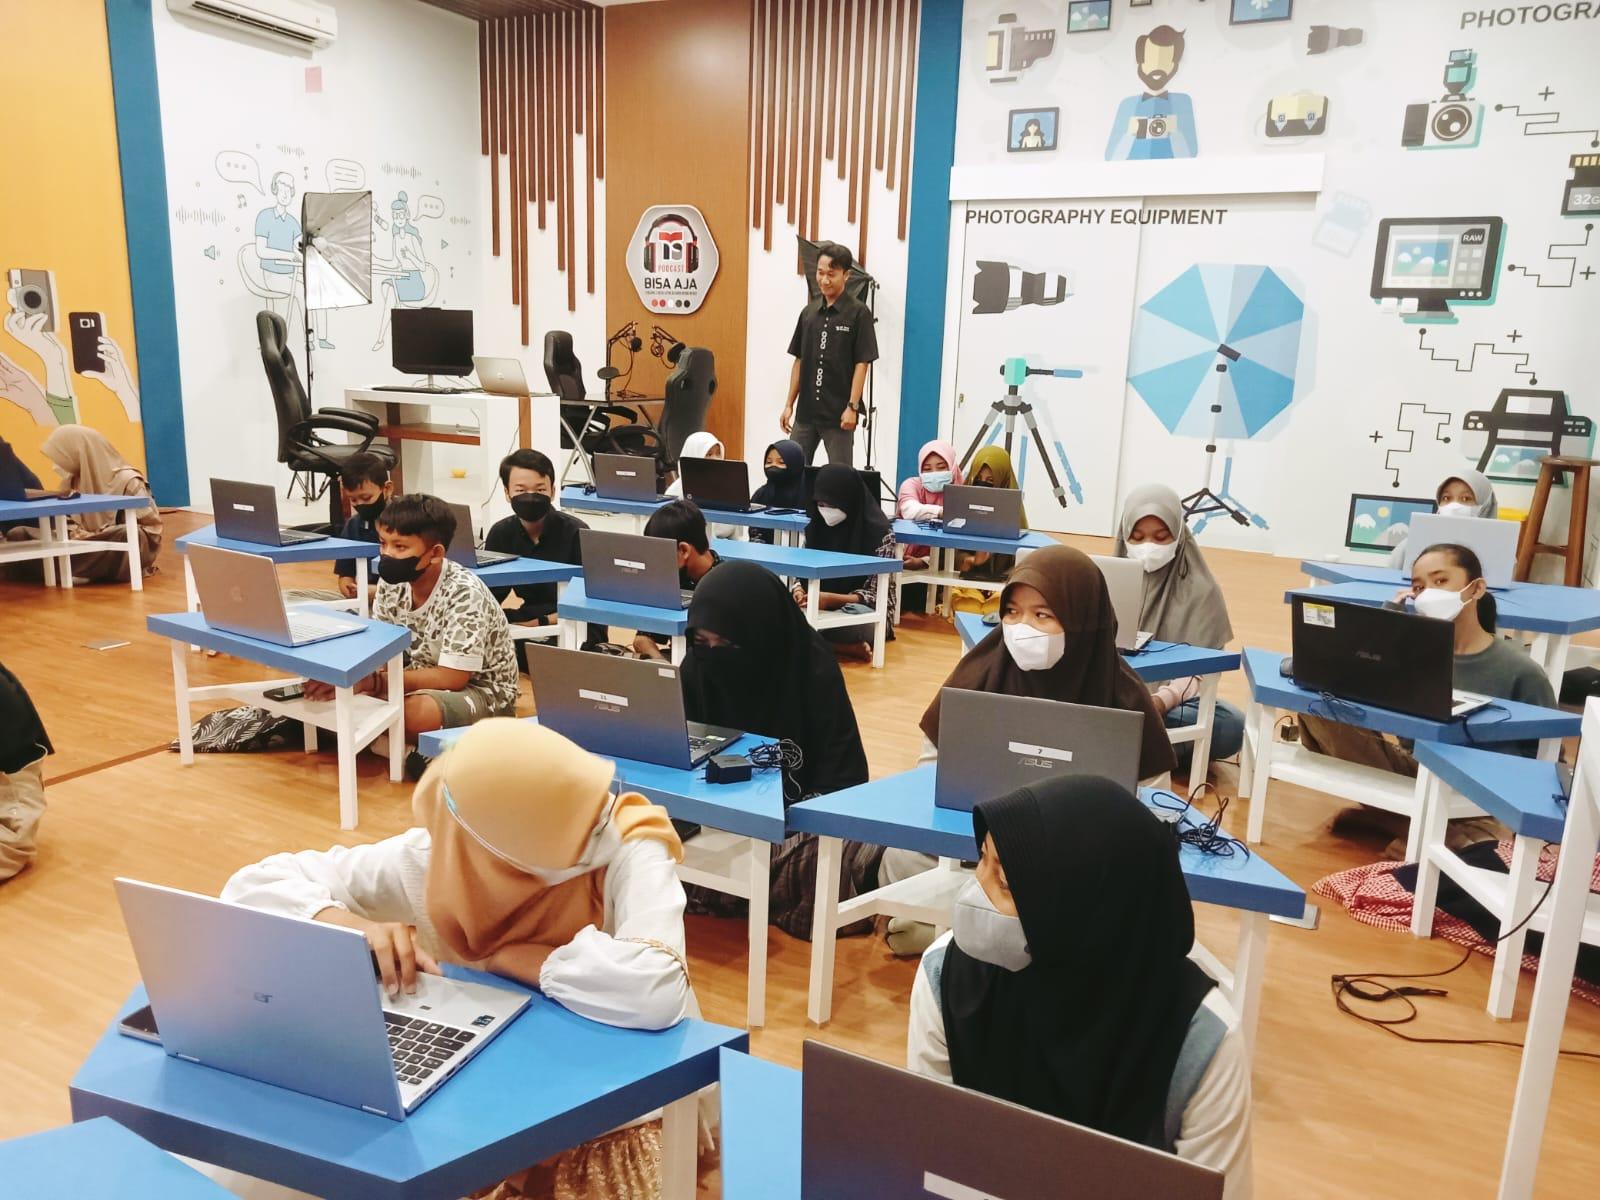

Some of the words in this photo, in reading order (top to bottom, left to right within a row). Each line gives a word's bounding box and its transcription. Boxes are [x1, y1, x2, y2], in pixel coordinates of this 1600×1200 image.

[966, 208, 1105, 225] PHOTOGRAPHY
[1110, 208, 1228, 225] EQUIPMENT
[1462, 233, 1484, 242] RAW
[658, 264, 685, 273] PODCAST
[644, 277, 671, 290] BISA
[674, 277, 698, 290] AJA
